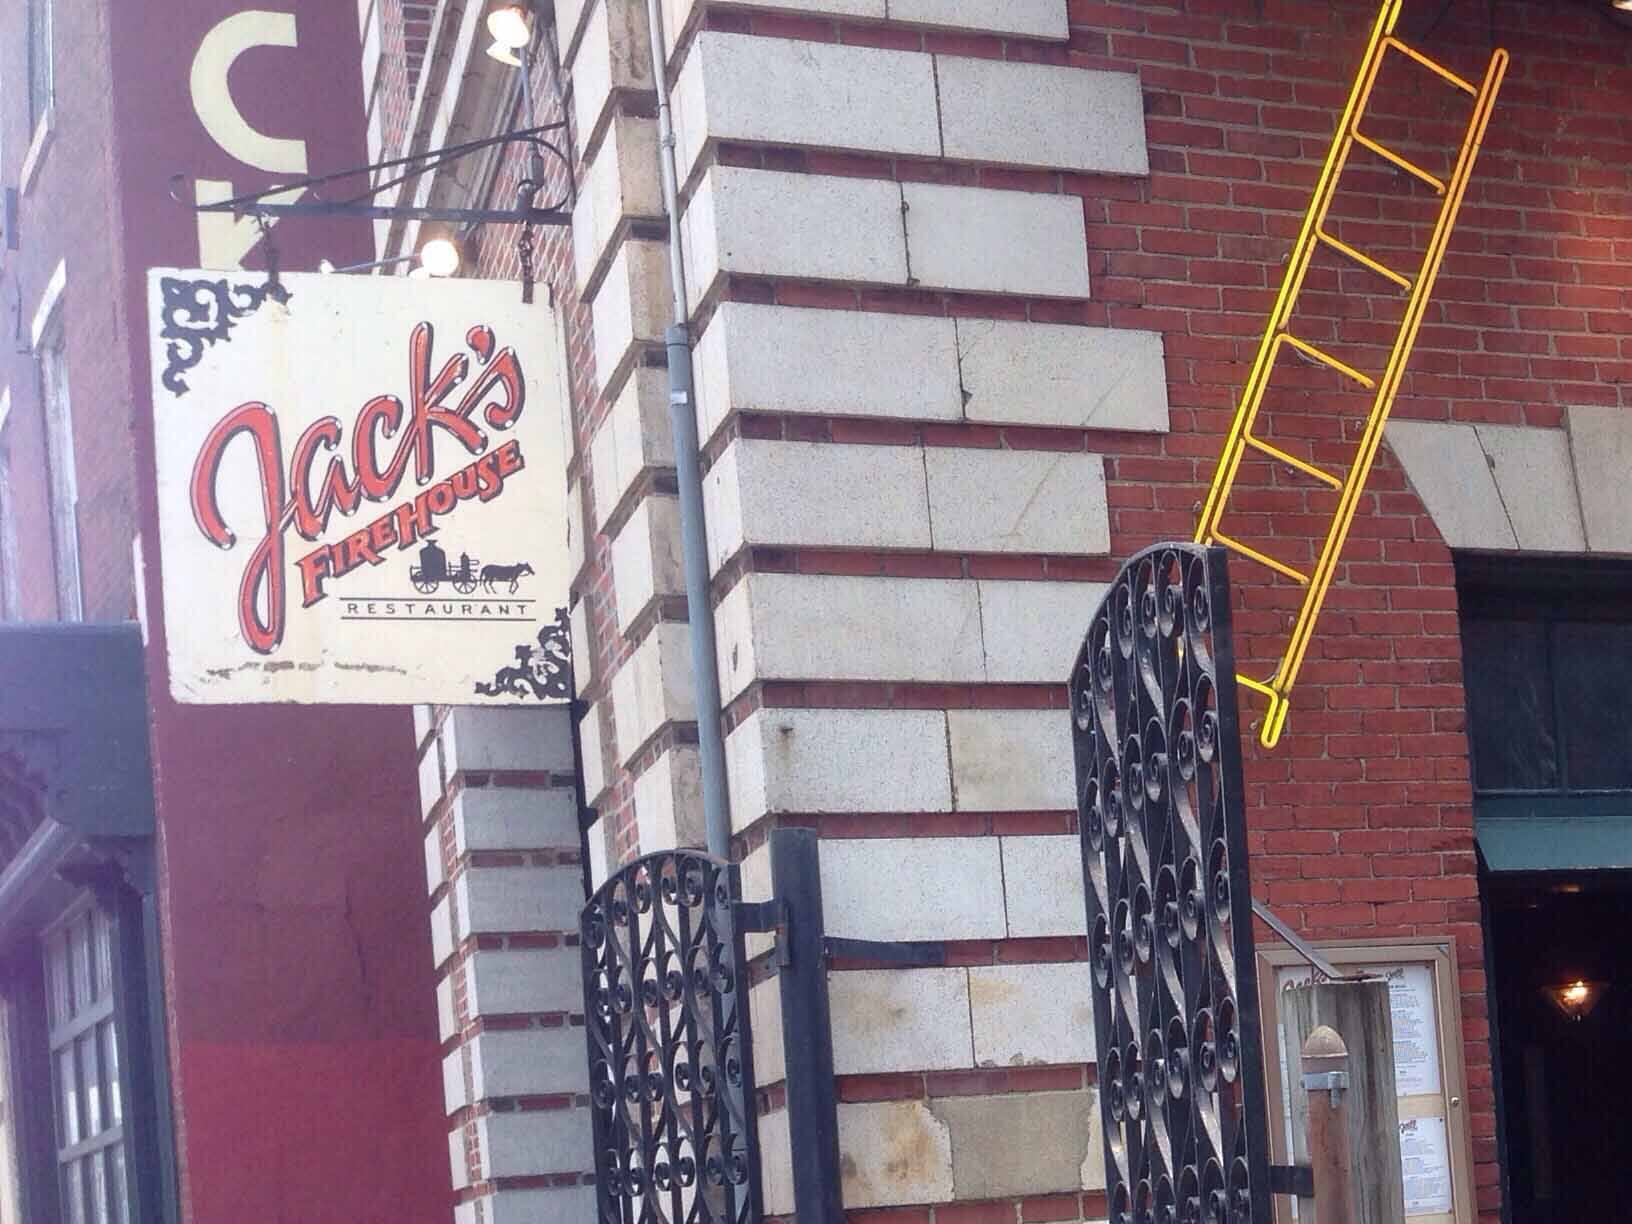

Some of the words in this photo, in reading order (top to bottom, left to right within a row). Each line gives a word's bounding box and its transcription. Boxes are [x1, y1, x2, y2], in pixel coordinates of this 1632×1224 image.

[190, 321, 527, 655] Jack's
[296, 439, 525, 608] FIREHOUSE
[347, 603, 527, 615] RESTAURANT
